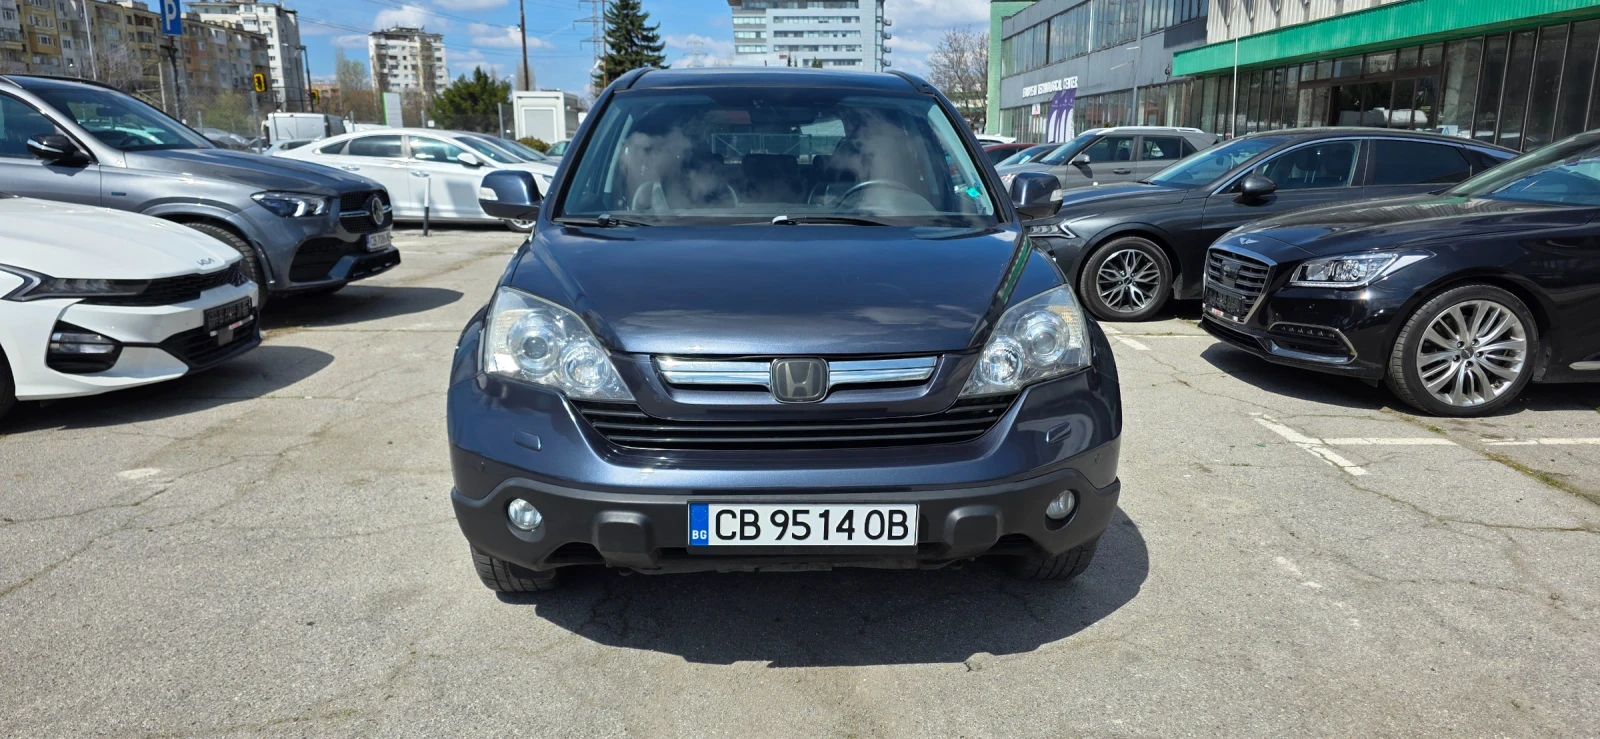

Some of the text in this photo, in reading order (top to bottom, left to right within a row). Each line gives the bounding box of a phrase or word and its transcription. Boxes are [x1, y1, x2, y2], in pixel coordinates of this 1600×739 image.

[164, 0, 177, 30] P
[692, 530, 707, 540] BG
[715, 509, 761, 541] CB
[770, 509, 855, 541] 9514
